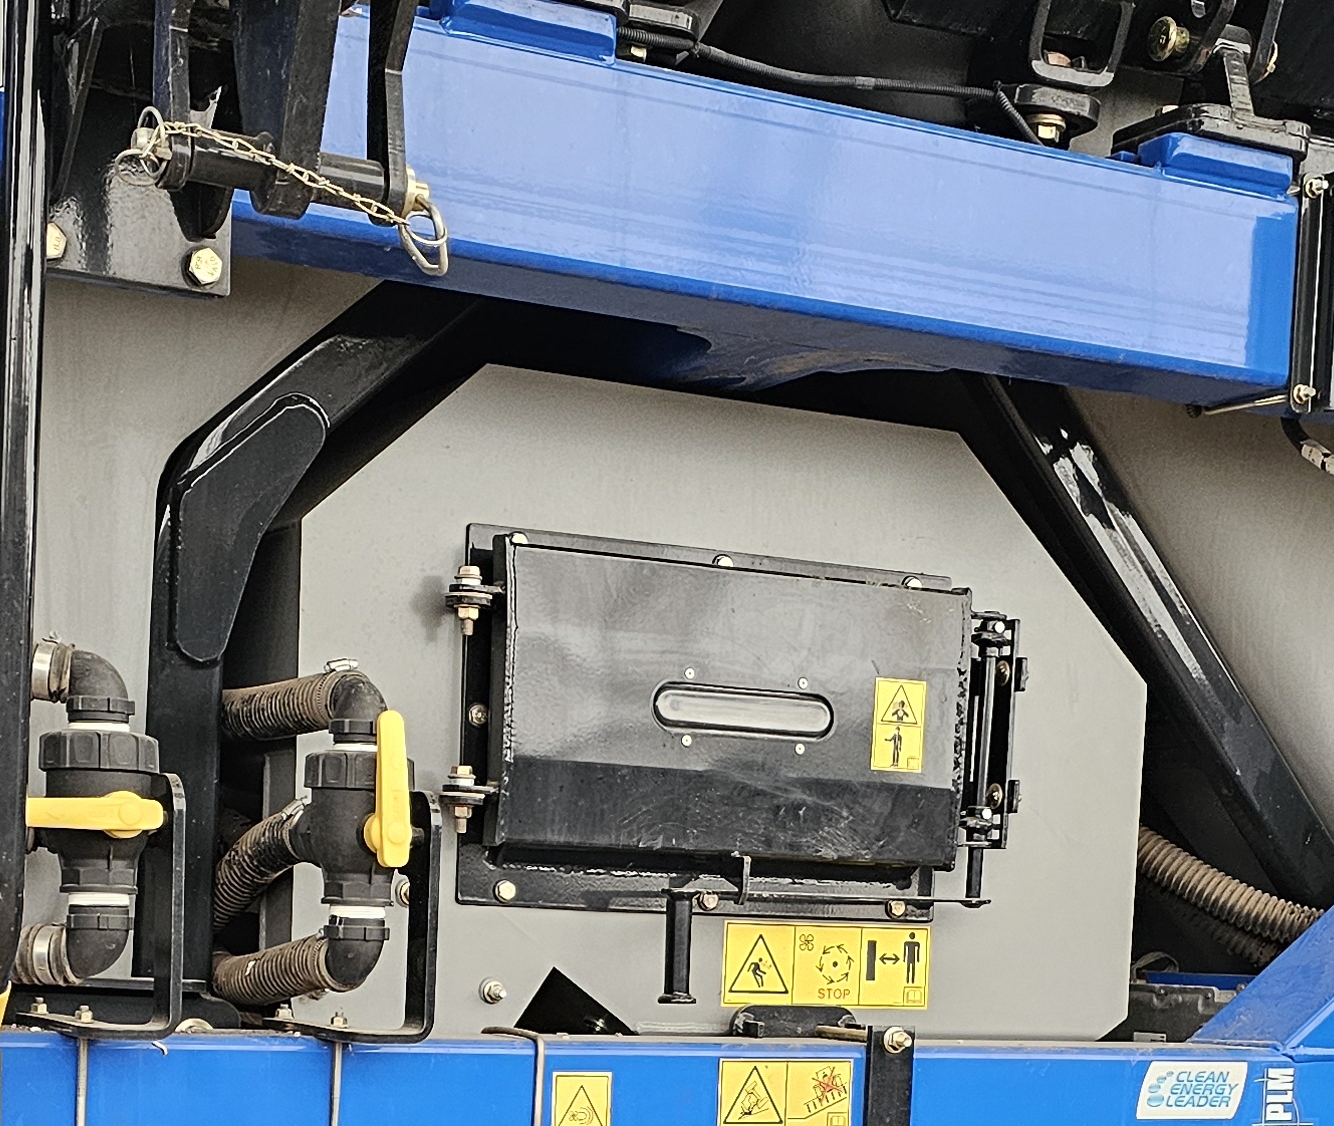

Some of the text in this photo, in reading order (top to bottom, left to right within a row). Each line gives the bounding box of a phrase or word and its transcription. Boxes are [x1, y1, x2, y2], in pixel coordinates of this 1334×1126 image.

[818, 988, 850, 1000] STOP
[1176, 1071, 1230, 1083] CLEAN
[1170, 1083, 1239, 1095] ENERGY
[1266, 1068, 1295, 1121] PLM
[1166, 1095, 1231, 1108] LEADER
